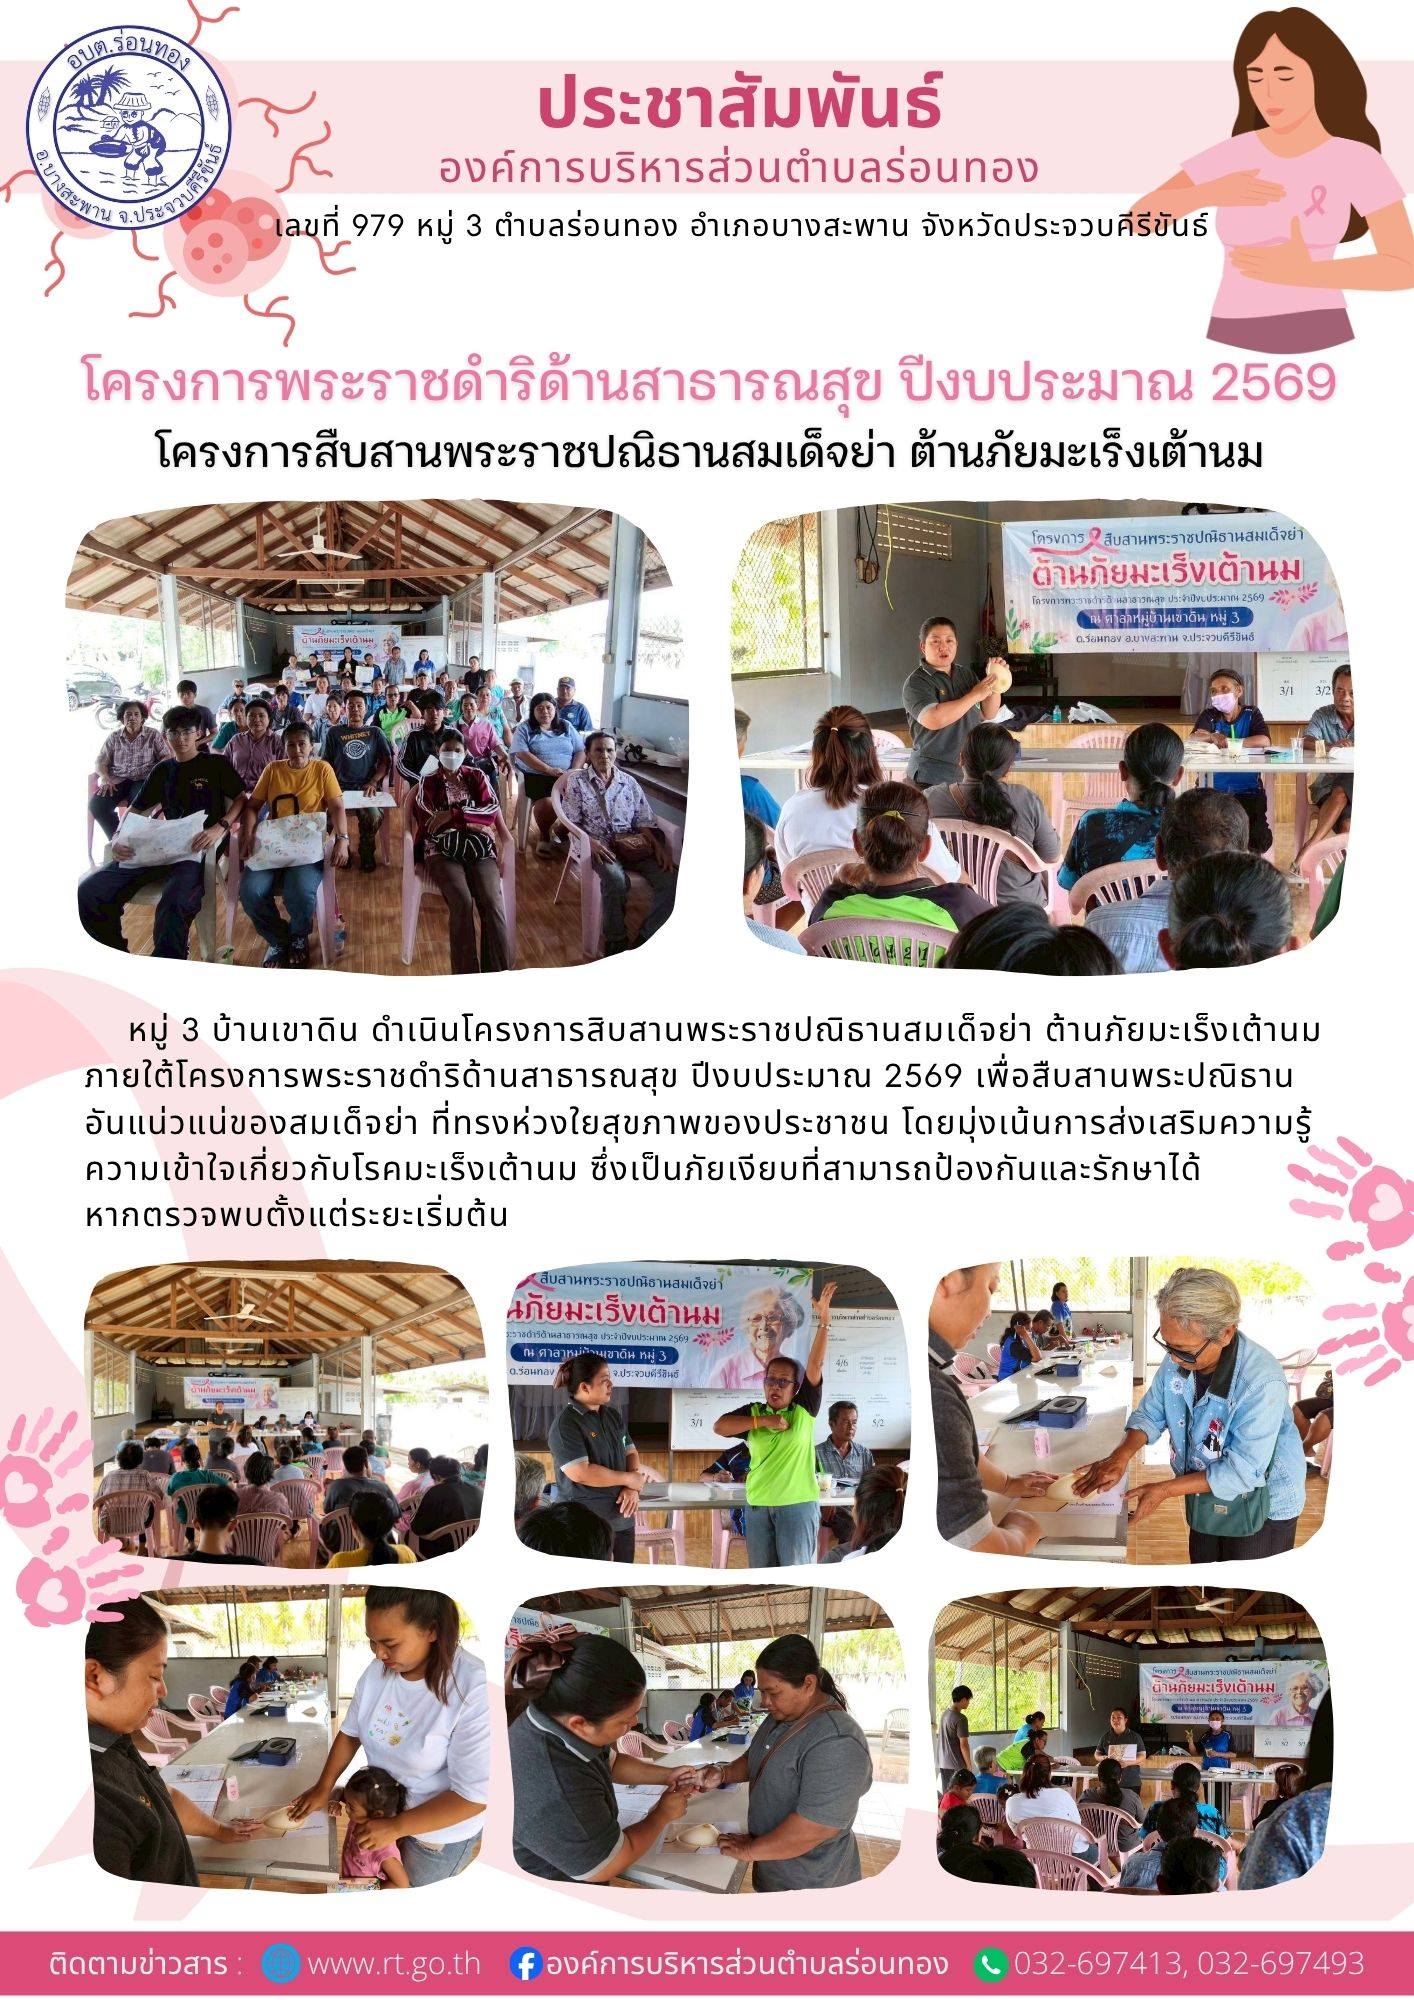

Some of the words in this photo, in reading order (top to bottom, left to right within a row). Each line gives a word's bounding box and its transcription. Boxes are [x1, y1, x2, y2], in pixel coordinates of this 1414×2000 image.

[1032, 530, 1085, 546] โครงการ
[1104, 527, 1304, 547] สืบสานพระราชปณิธานสมเด็จย่า
[1032, 551, 1301, 586] ต้านภัยมะเร็งเต้านม
[1241, 593, 1265, 604] 2569
[1105, 610, 1206, 627] ศาลาหมู่บ้านเขาดิน
[1210, 611, 1226, 627] หมู่
[1231, 613, 1240, 625] 3
[1315, 685, 1331, 696] 3/2
[540, 1271, 723, 1290] สืบสานพระราชปณิธานสมเด็จย่า
[669, 1335, 689, 1343] 2569
[523, 1347, 535, 1358] ณ
[640, 1347, 655, 1363] หมู่
[658, 1349, 668, 1361] 3
[1152, 1678, 1275, 1694] ต้านภัยมะเร็งเต้านม
